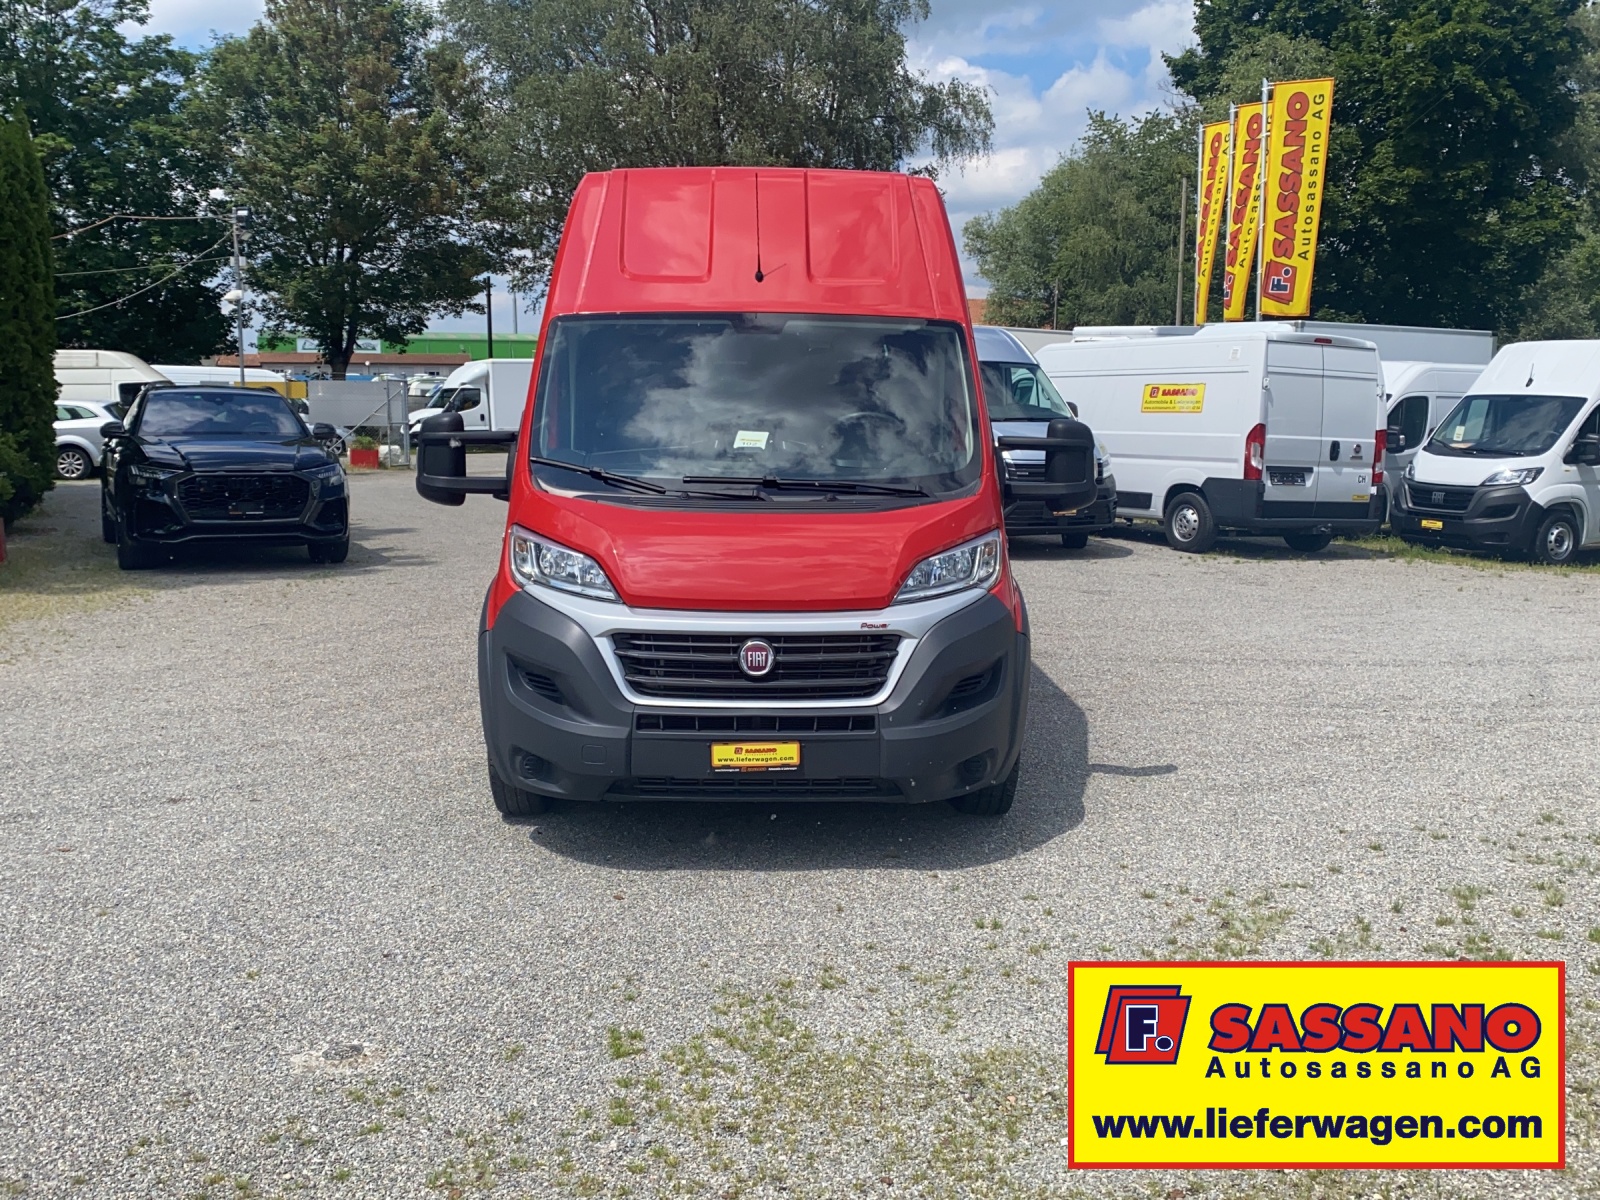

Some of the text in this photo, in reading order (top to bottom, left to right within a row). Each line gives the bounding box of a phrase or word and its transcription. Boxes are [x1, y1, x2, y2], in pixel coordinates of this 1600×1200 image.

[1272, 91, 1310, 260] SASSANO
[1298, 93, 1325, 261] Autosassano AG
[1226, 112, 1263, 268] SASSANO
[1357, 475, 1367, 484] CH
[1431, 491, 1446, 504] FIAT
[860, 622, 891, 630] Power
[747, 651, 767, 667] FIAT
